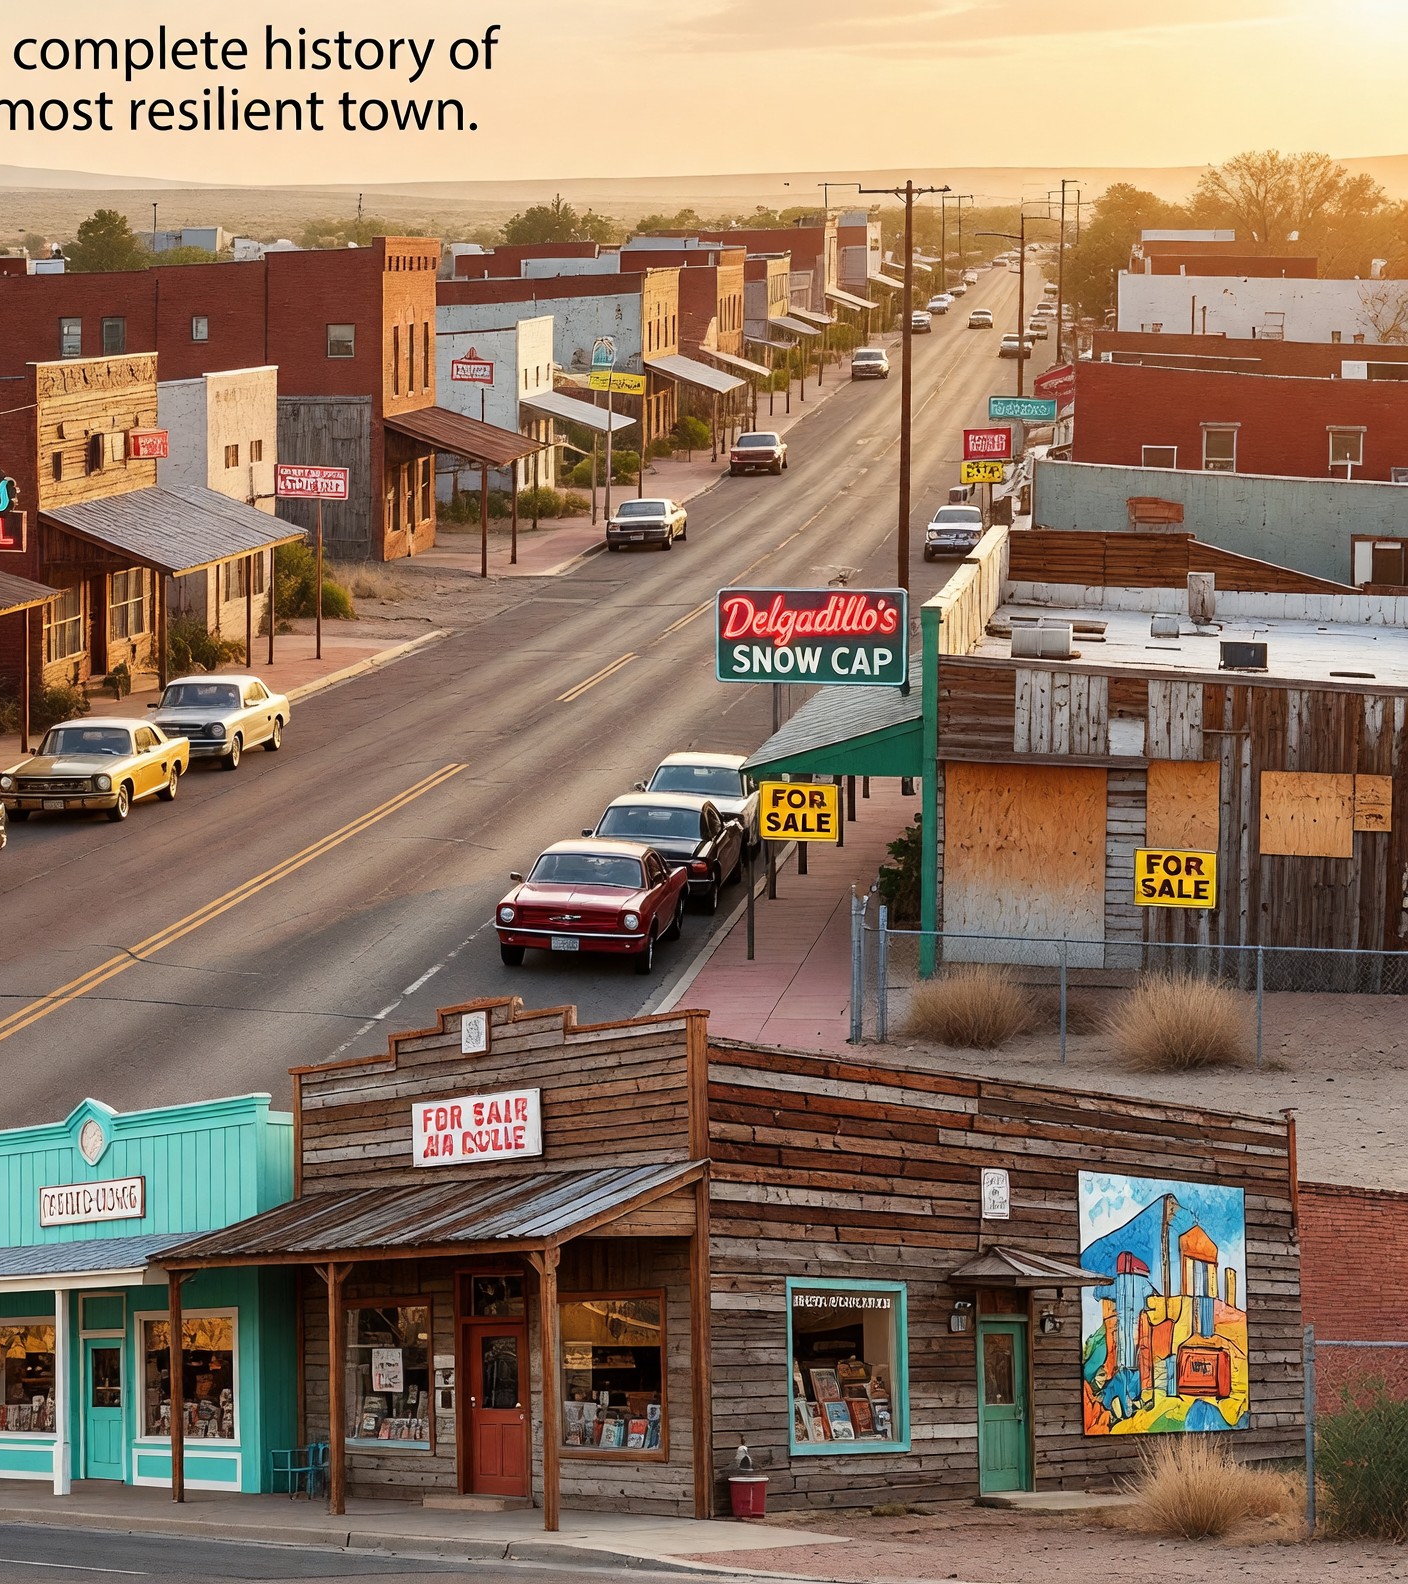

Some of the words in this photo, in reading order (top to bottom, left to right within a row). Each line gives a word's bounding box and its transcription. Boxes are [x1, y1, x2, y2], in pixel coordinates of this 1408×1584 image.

[723, 595, 898, 646] Delgadillo's
[732, 645, 822, 674] SNOW
[831, 647, 893, 676] CAP
[772, 789, 827, 809] FOR
[766, 812, 831, 833] SALE
[1146, 854, 1205, 876] FOR
[1140, 878, 1209, 899] SALE
[423, 1105, 462, 1133] FOR
